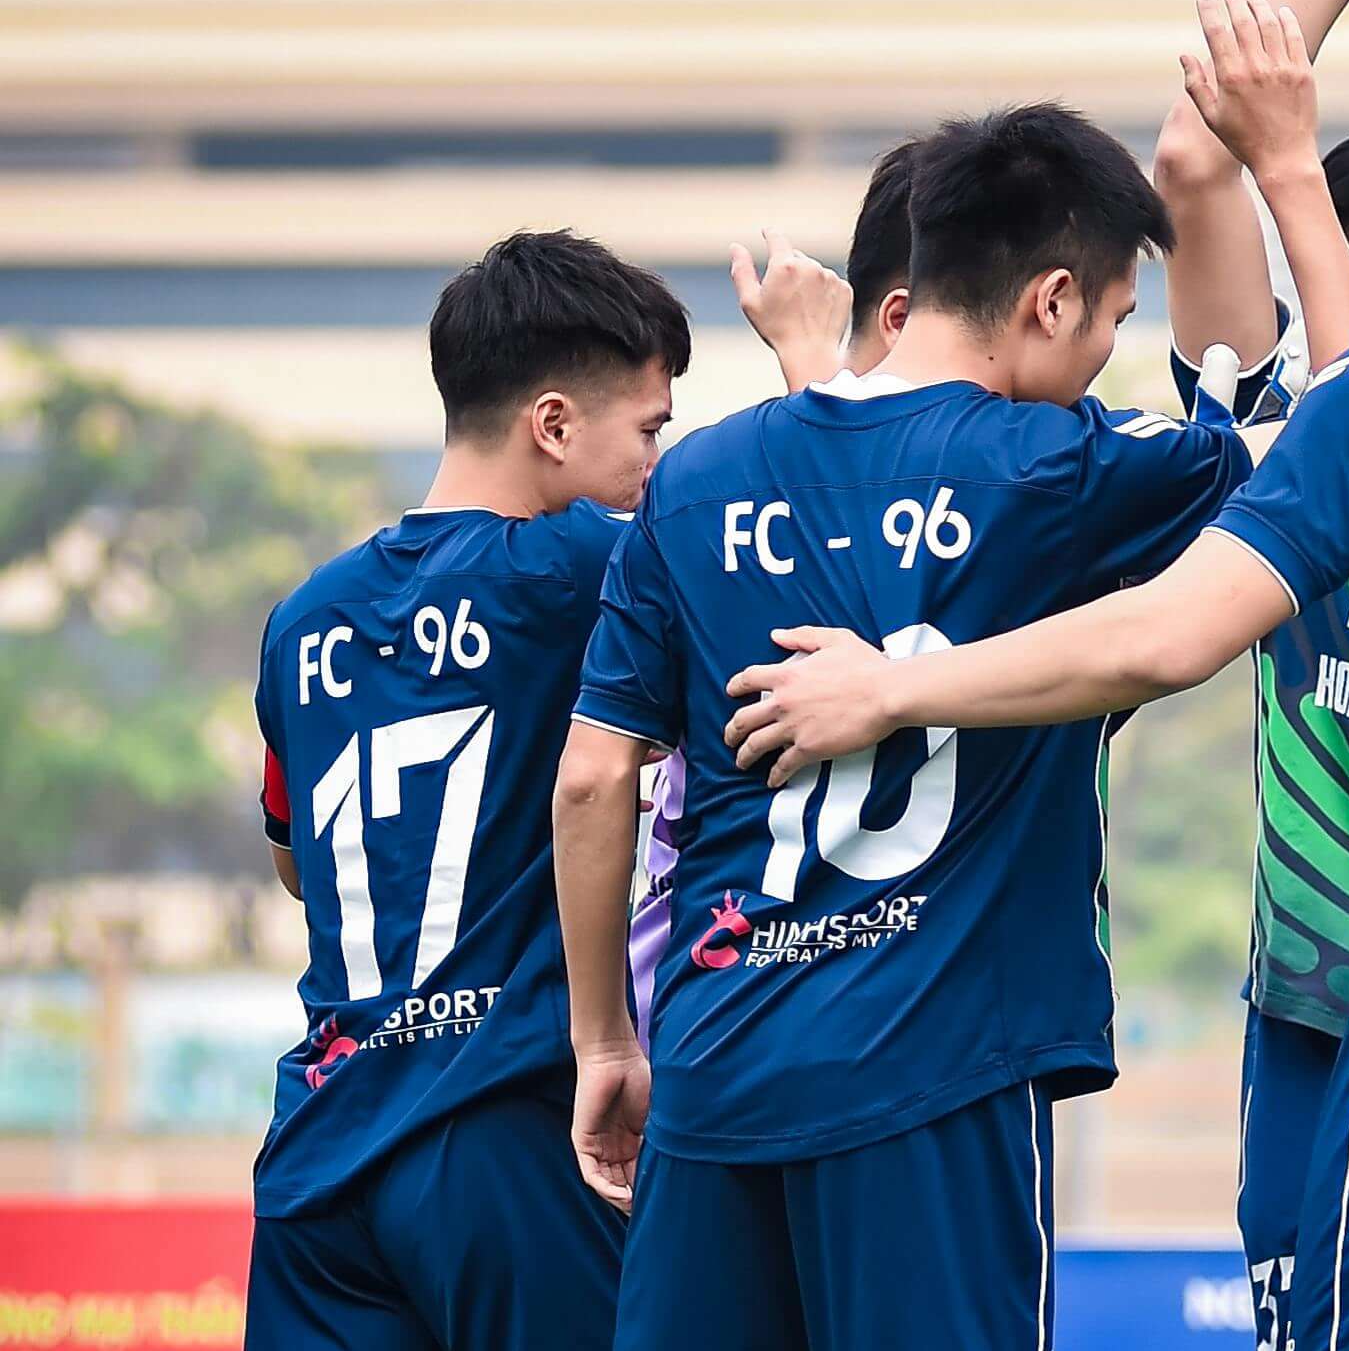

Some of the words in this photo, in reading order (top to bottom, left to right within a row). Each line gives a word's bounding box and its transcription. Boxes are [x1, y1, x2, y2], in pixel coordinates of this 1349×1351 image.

[724, 501, 795, 575] FC
[882, 487, 971, 569] 96
[299, 626, 353, 706] FC
[414, 598, 490, 677] 96
[312, 705, 495, 1002] 17
[852, 932, 880, 947] MY
[398, 1032, 415, 1045] IS
[425, 1026, 444, 1039] MY
